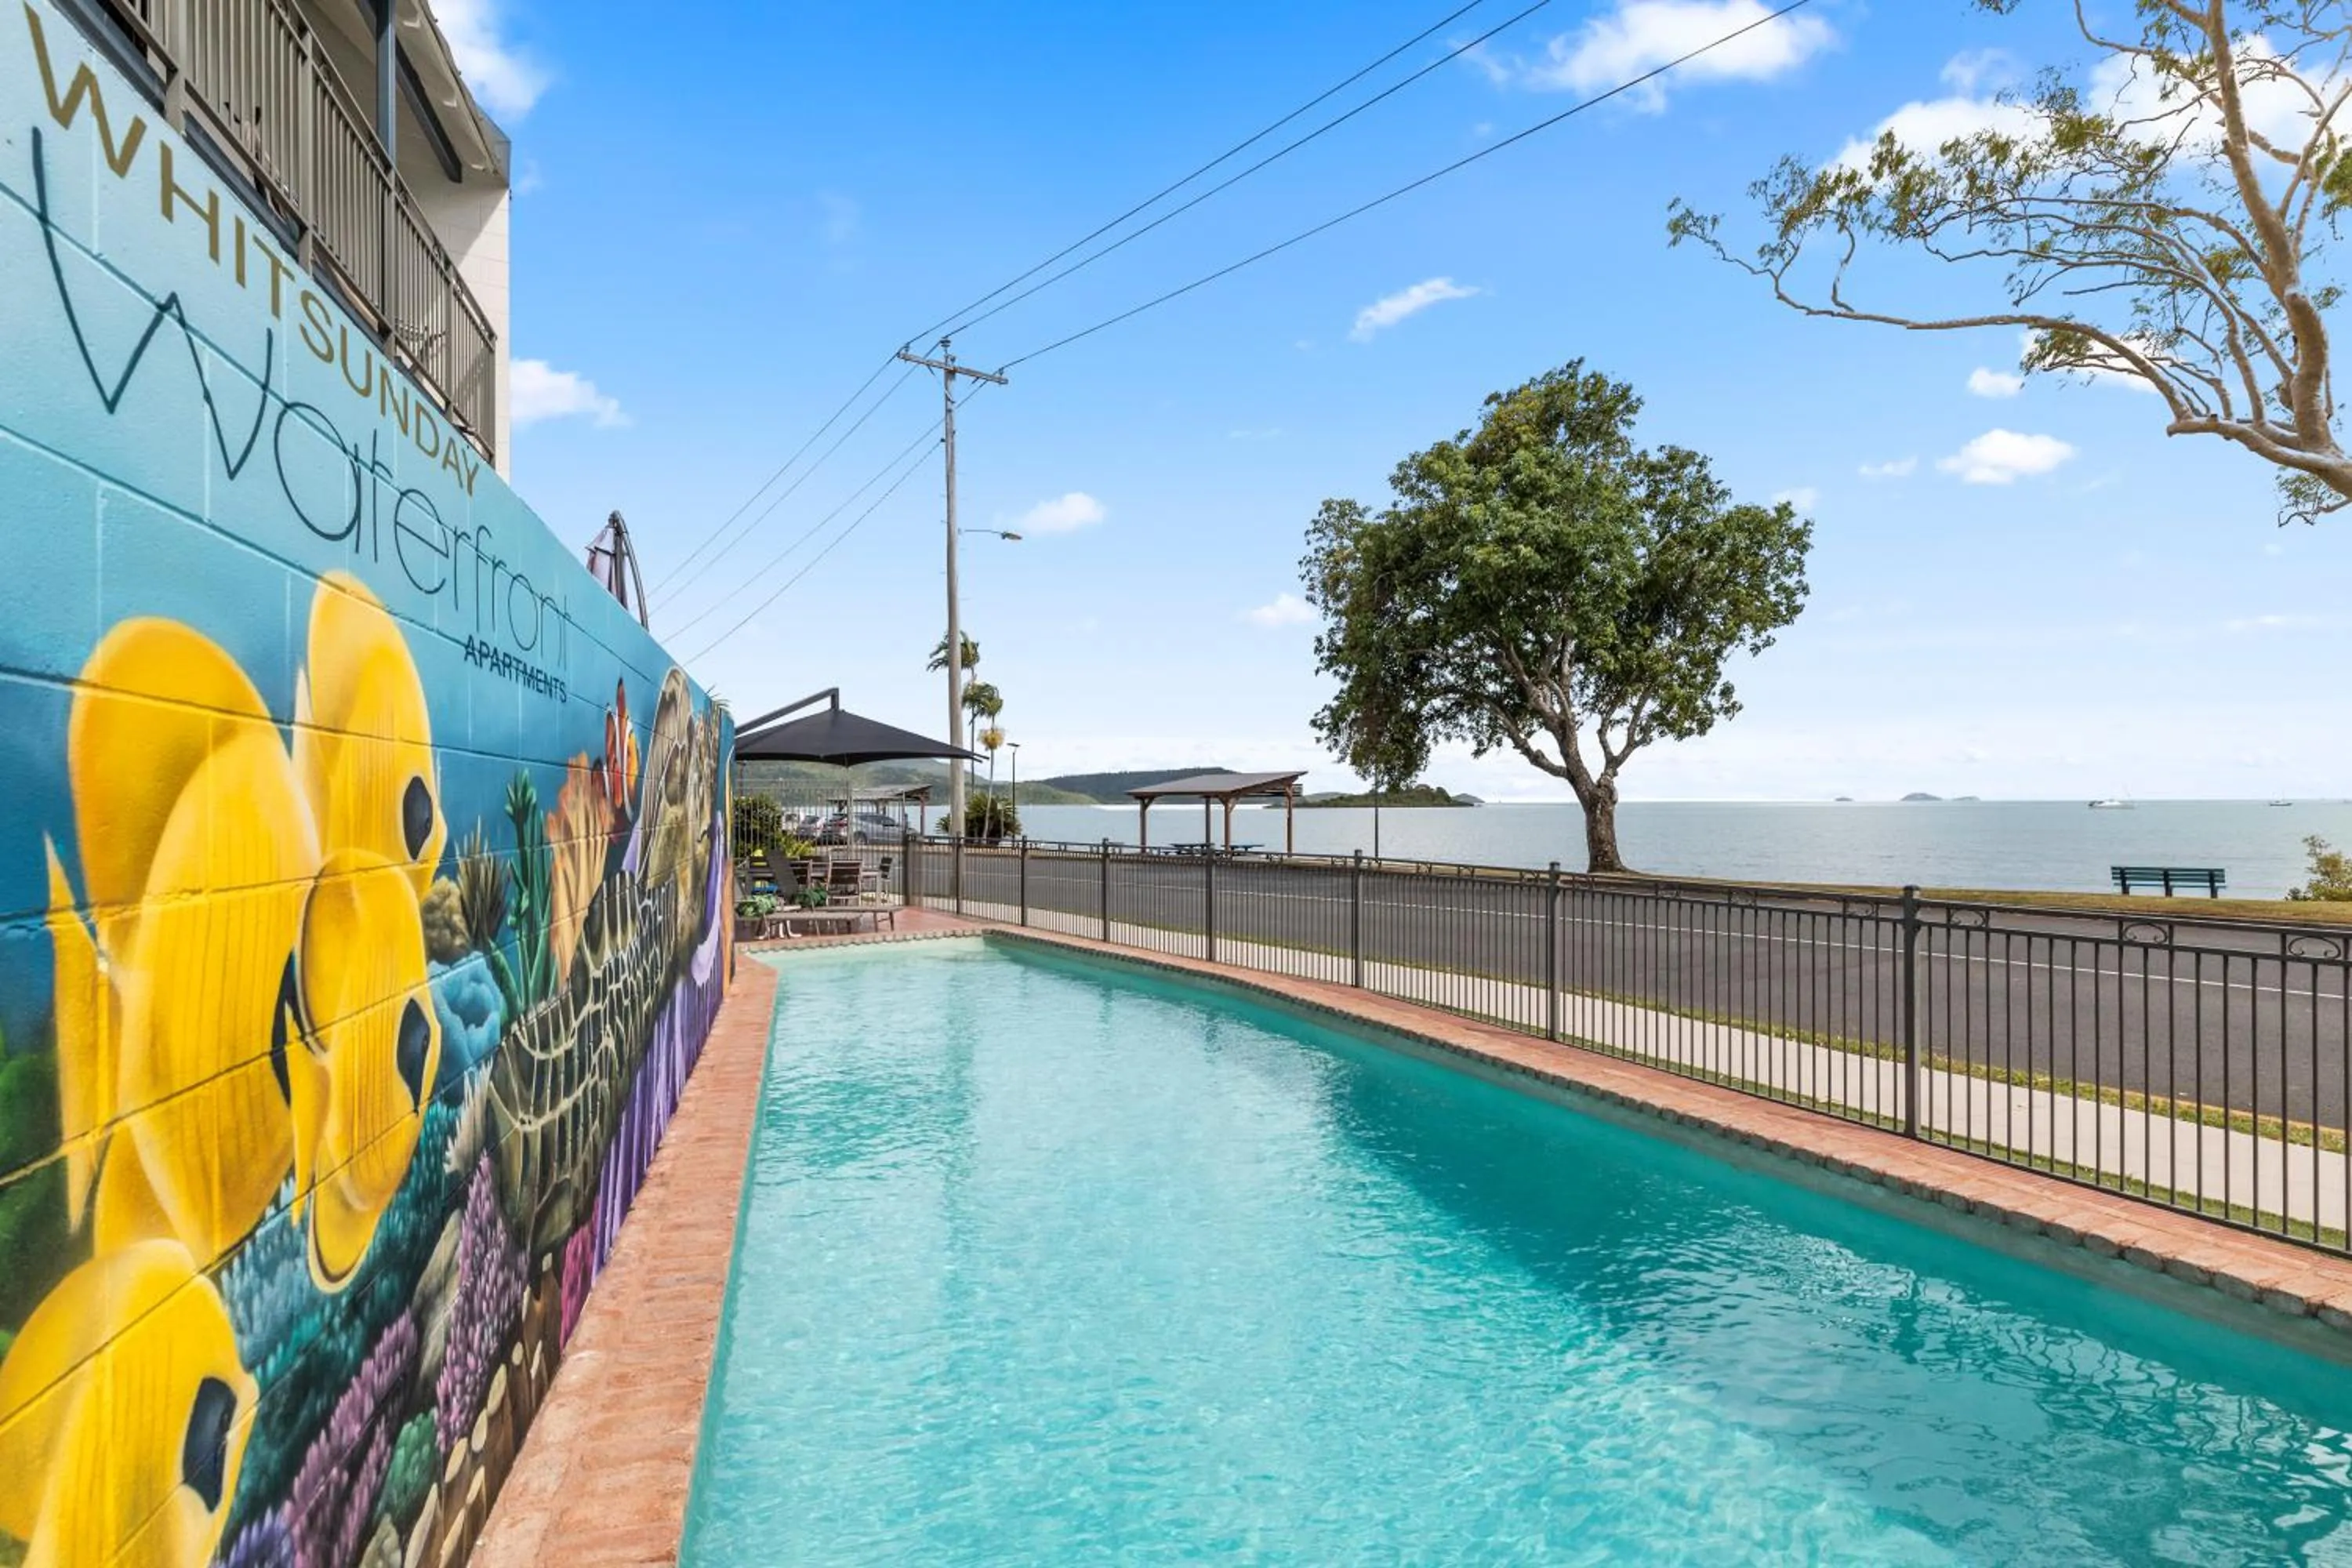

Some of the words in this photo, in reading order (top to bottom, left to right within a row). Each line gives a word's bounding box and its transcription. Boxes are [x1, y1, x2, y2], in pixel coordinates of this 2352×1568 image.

[23, 0, 479, 496] WHITSUNDAY
[31, 125, 572, 670] Waterfront
[463, 634, 567, 703] APARTMENTS
